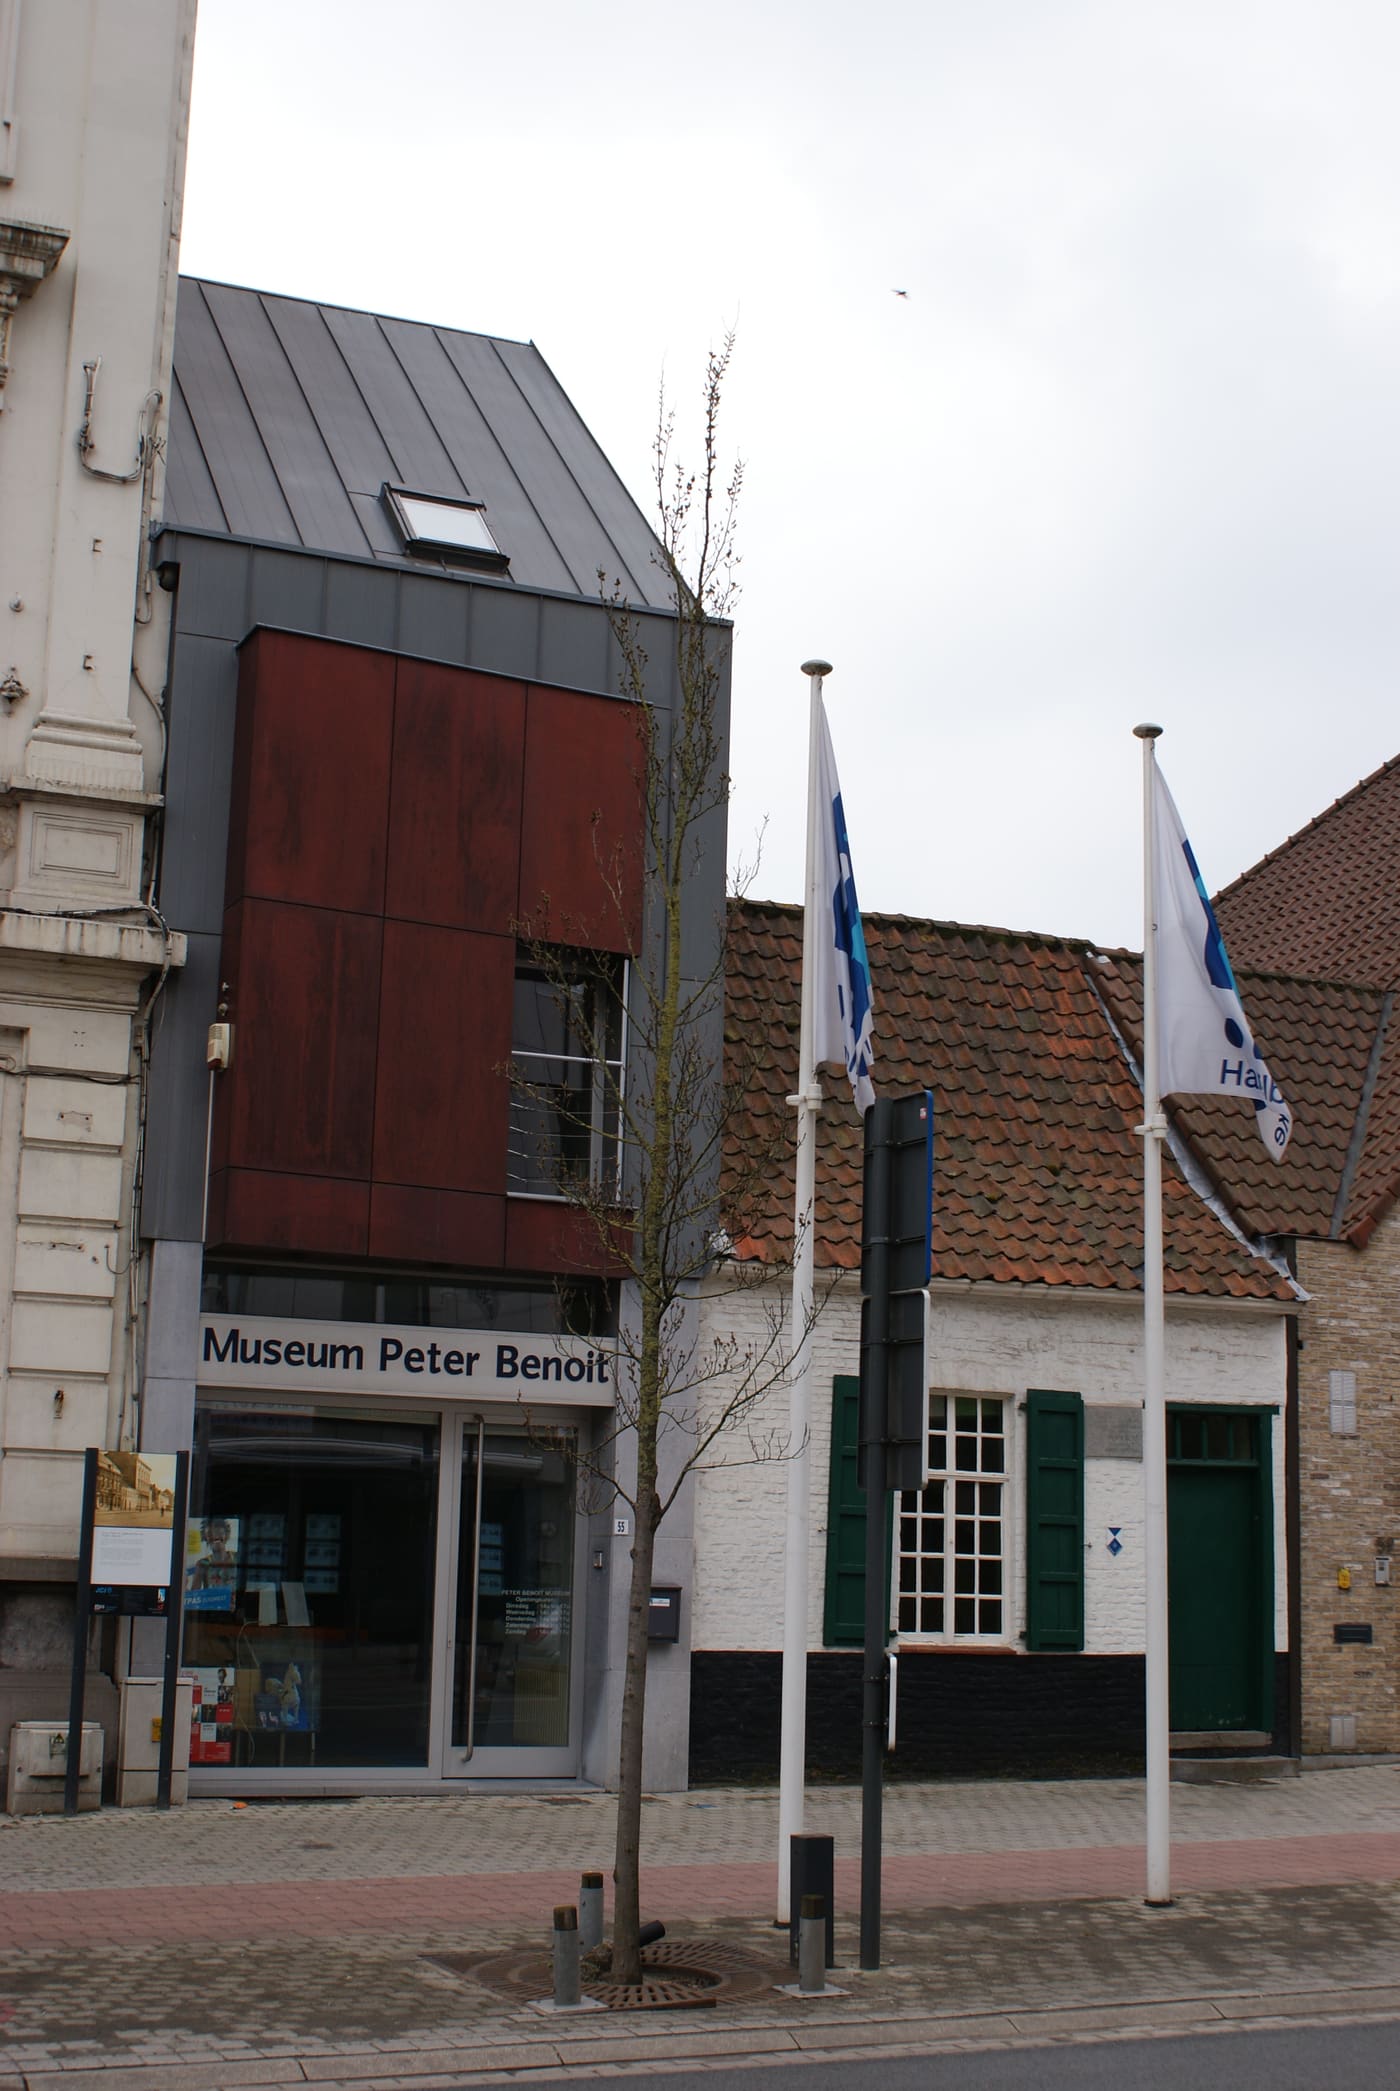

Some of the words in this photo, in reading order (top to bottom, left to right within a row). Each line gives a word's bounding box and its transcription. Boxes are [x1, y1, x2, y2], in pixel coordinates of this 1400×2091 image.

[203, 1327, 363, 1370] Museum
[379, 1338, 480, 1376] Peter
[496, 1344, 609, 1383] Benoit
[617, 1521, 625, 1532] 55
